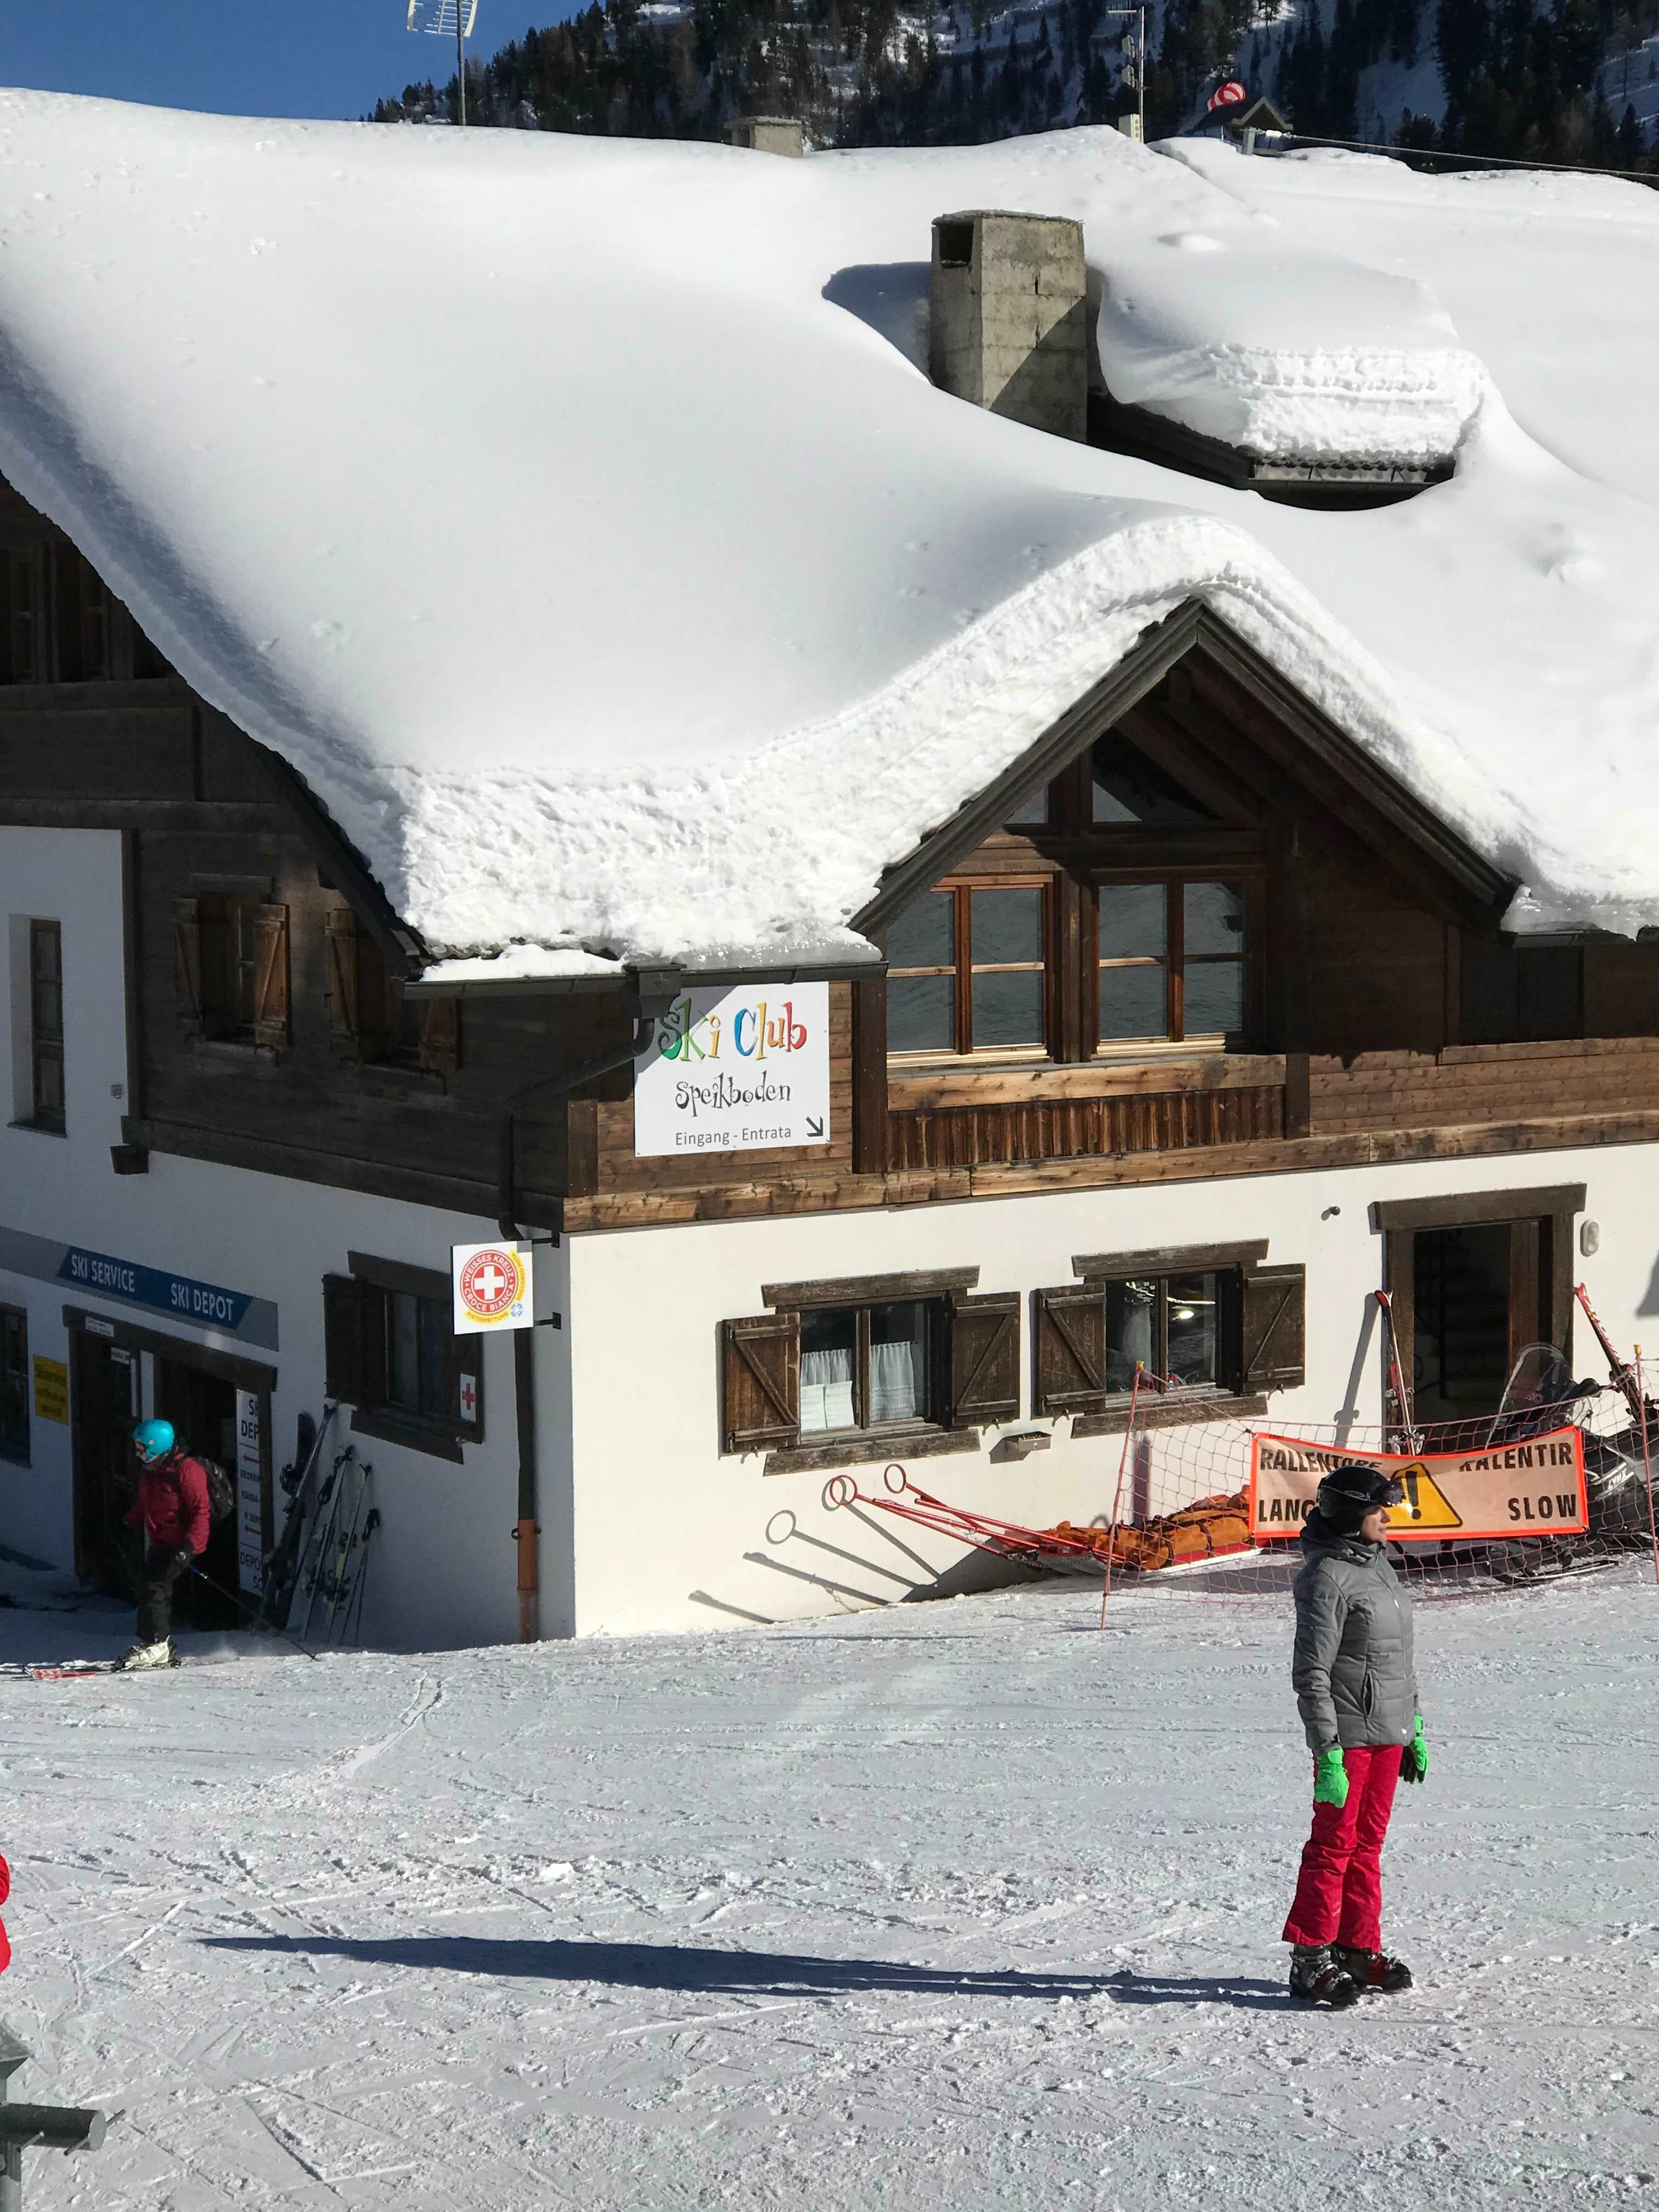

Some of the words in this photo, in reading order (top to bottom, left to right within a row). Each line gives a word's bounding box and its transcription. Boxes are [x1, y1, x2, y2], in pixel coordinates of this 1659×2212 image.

[658, 997, 721, 1063] Ski
[734, 1001, 807, 1062] Club
[675, 1071, 791, 1117] Speikboden
[676, 1131, 730, 1147] Eingang
[742, 1127, 792, 1141] Entrata
[71, 1254, 88, 1279] SKI
[91, 1260, 135, 1293] SERVICE
[464, 1254, 492, 1282] WEISSES
[493, 1255, 514, 1278] KREUZ
[171, 1283, 190, 1309] SKI
[194, 1289, 233, 1321] DEPOT
[464, 1288, 488, 1311] CROCE
[489, 1284, 515, 1311] BIANCA
[1508, 1494, 1576, 1521] SLOW
